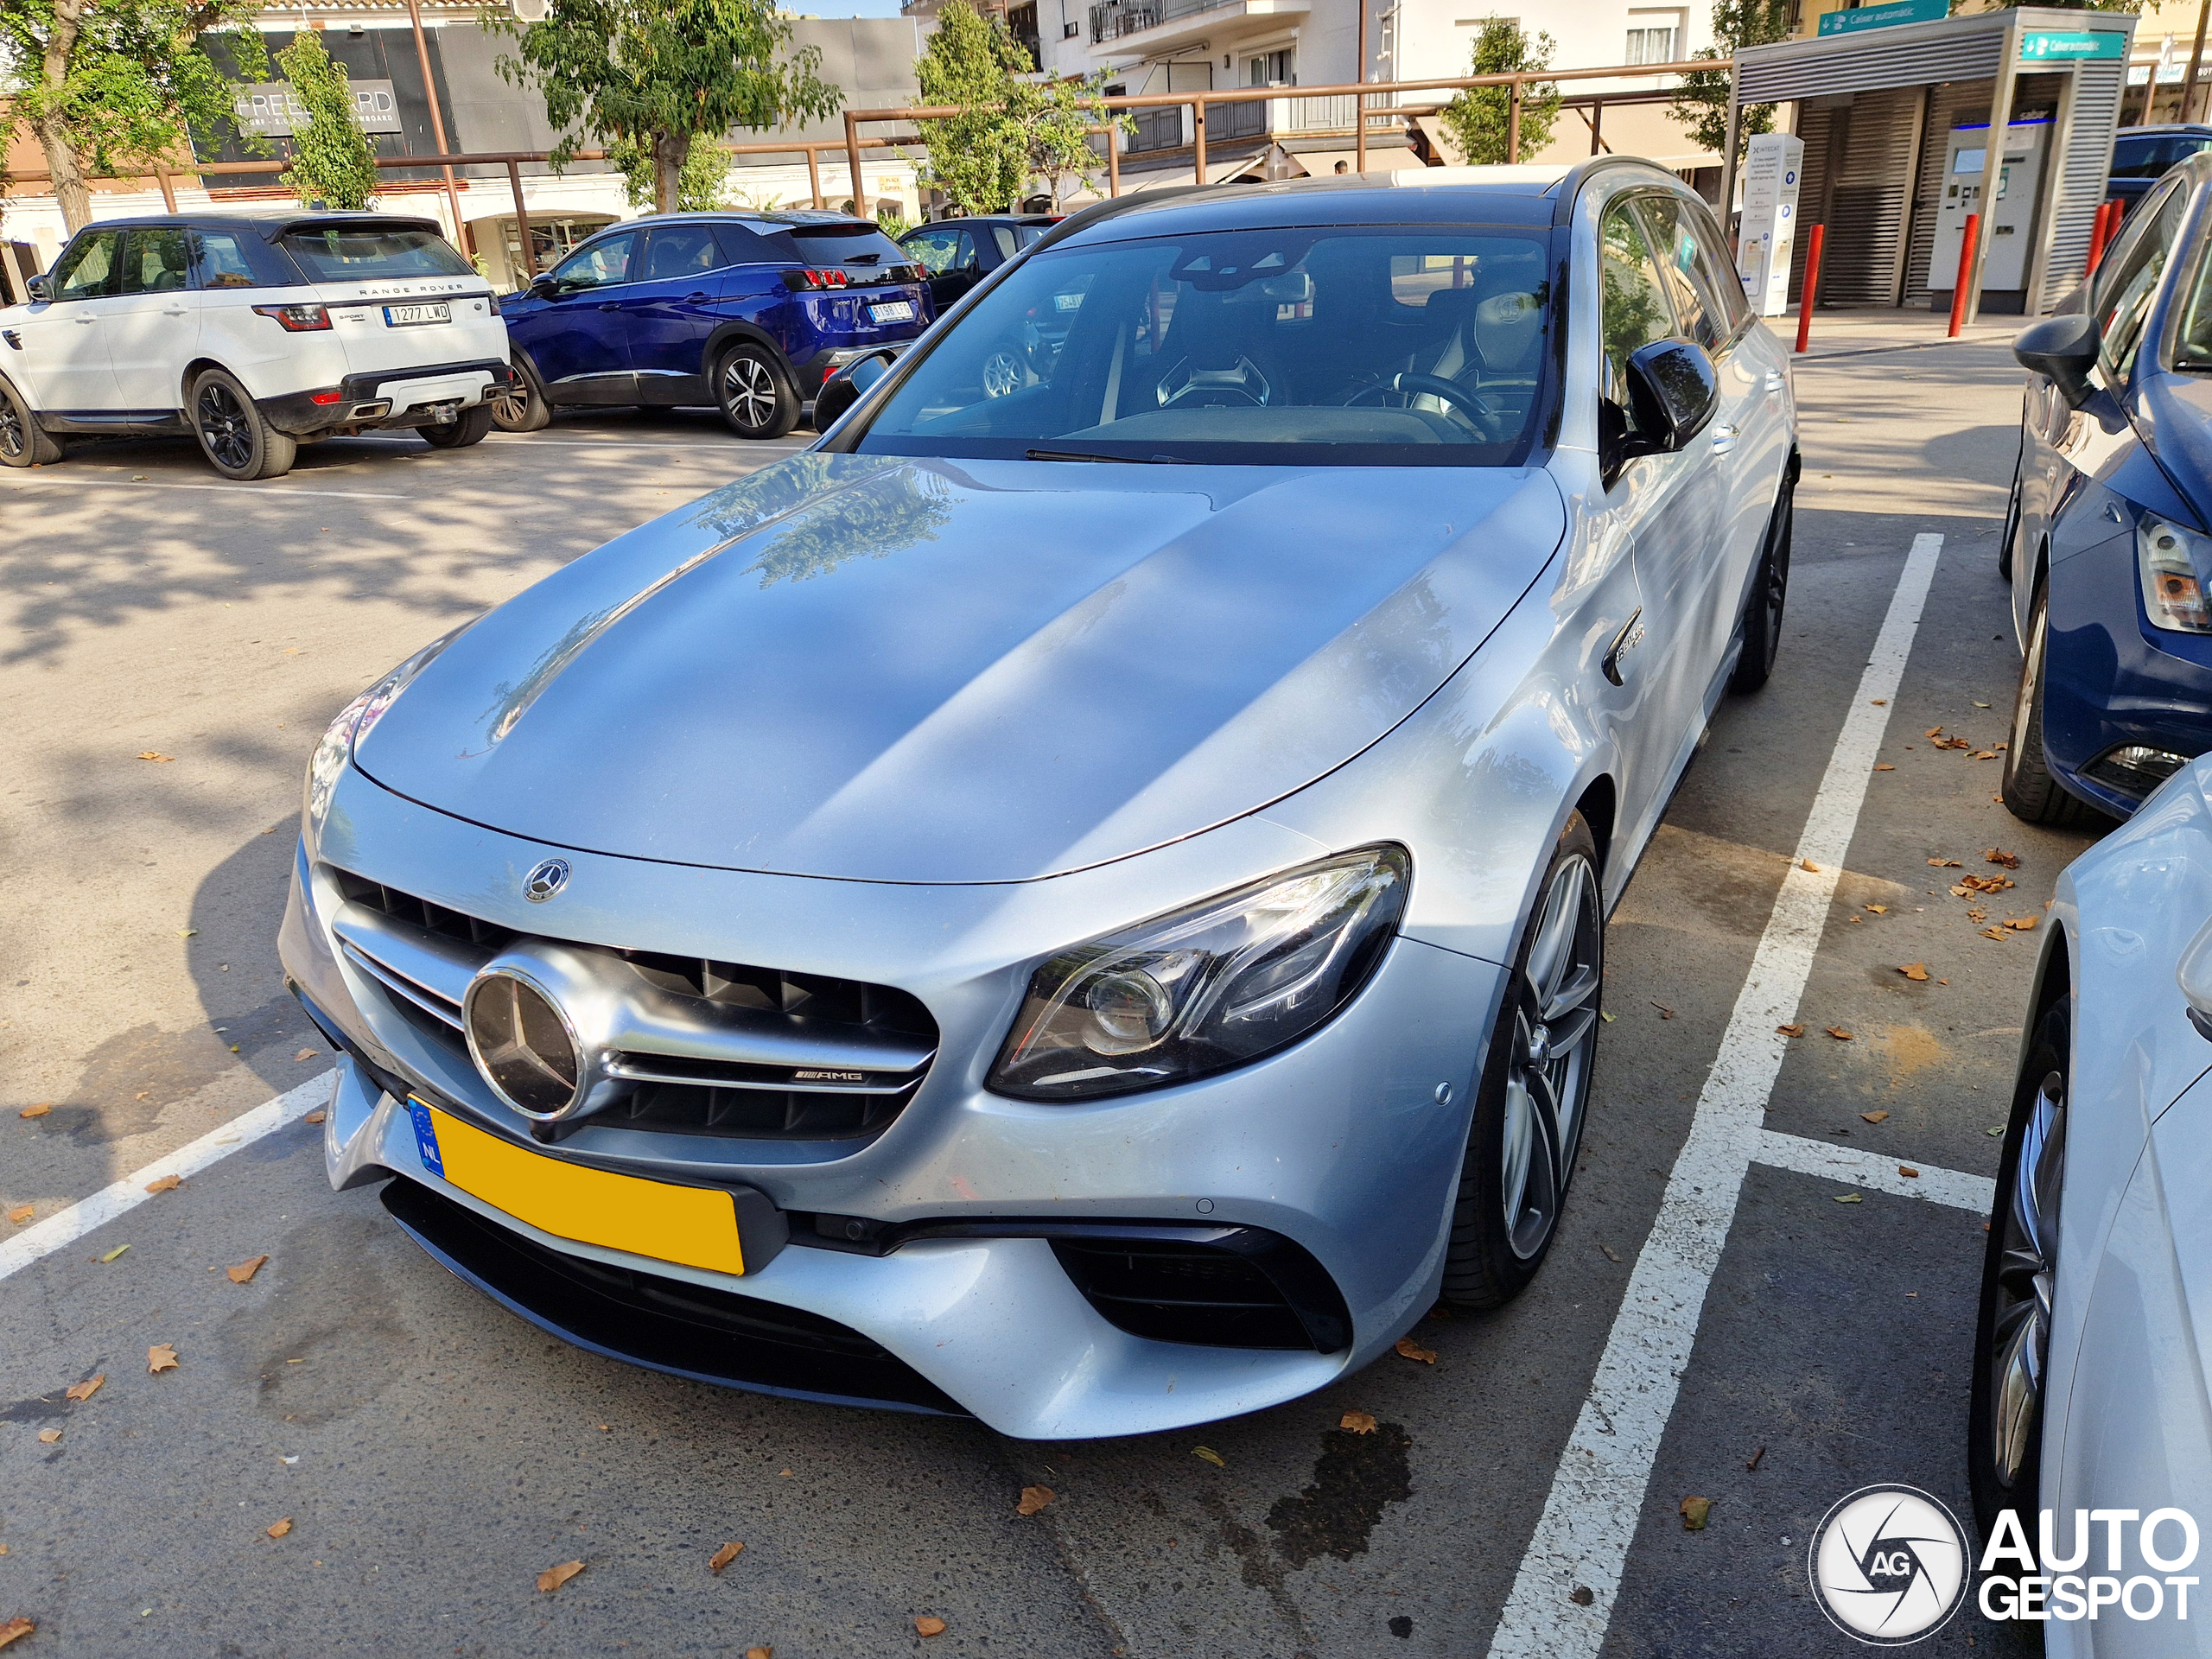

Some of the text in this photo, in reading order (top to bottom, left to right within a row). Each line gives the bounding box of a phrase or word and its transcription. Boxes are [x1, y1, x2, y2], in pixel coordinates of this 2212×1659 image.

[1850, 14, 1874, 25] Caixer
[359, 287, 410, 296] RANGE
[394, 305, 448, 321] 1277 LWD
[874, 303, 910, 317] 8198 LFG
[816, 1071, 862, 1080] AMG
[422, 1141, 441, 1164] NL
